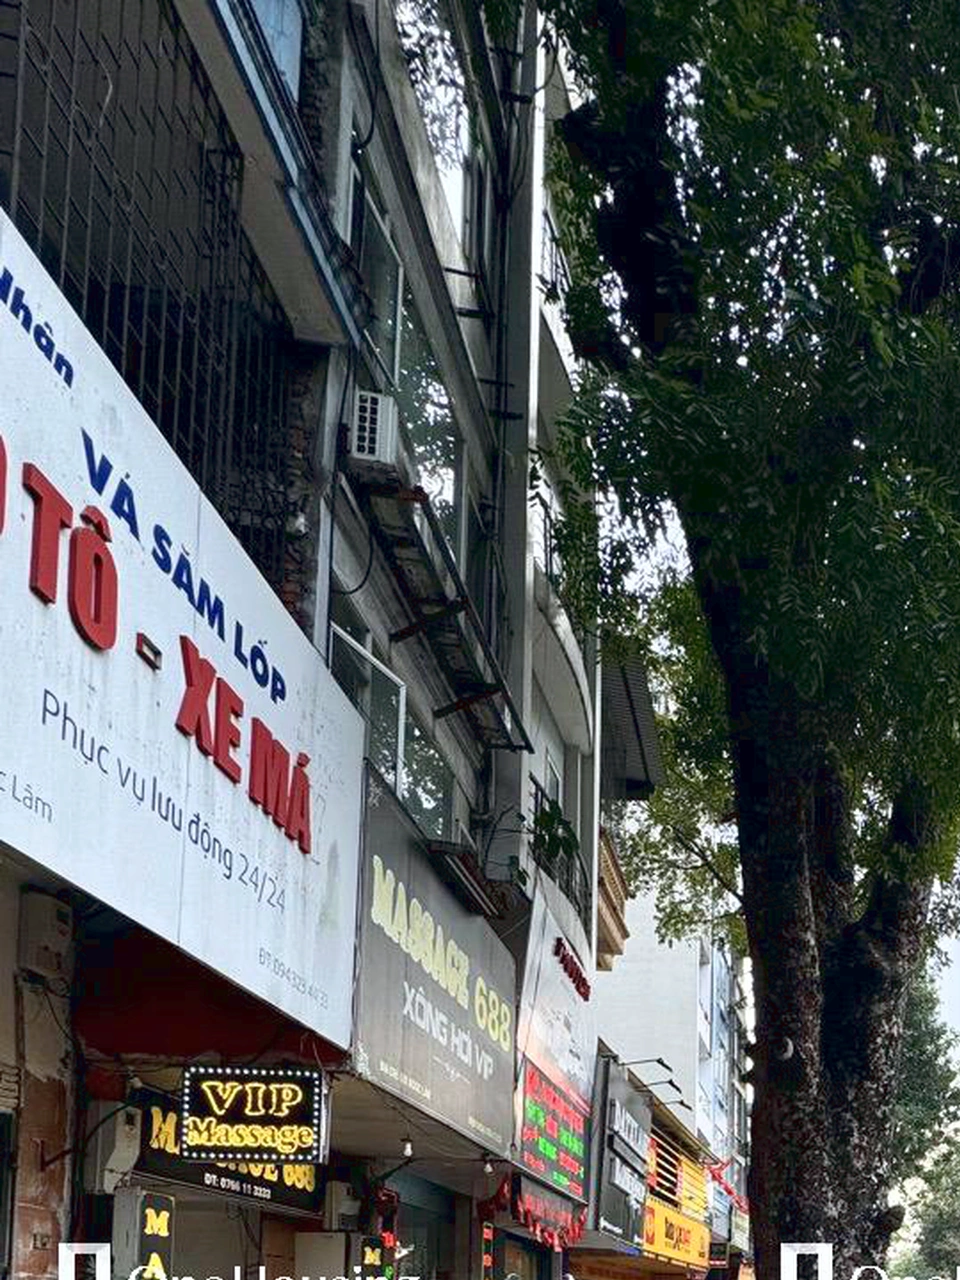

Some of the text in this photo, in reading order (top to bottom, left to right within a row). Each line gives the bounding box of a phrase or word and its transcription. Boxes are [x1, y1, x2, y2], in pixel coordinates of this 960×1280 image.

[81, 426, 286, 704] VÁ SĂM LỐP
[22, 462, 118, 652] TÔ
[175, 634, 244, 785] XE
[42, 688, 286, 915] Phục vụ lưu động 24/24
[403, 981, 448, 1047] XÔNG
[475, 976, 511, 1052] 688
[185, 1116, 316, 1154] Massage
[201, 1081, 303, 1117] VIP
